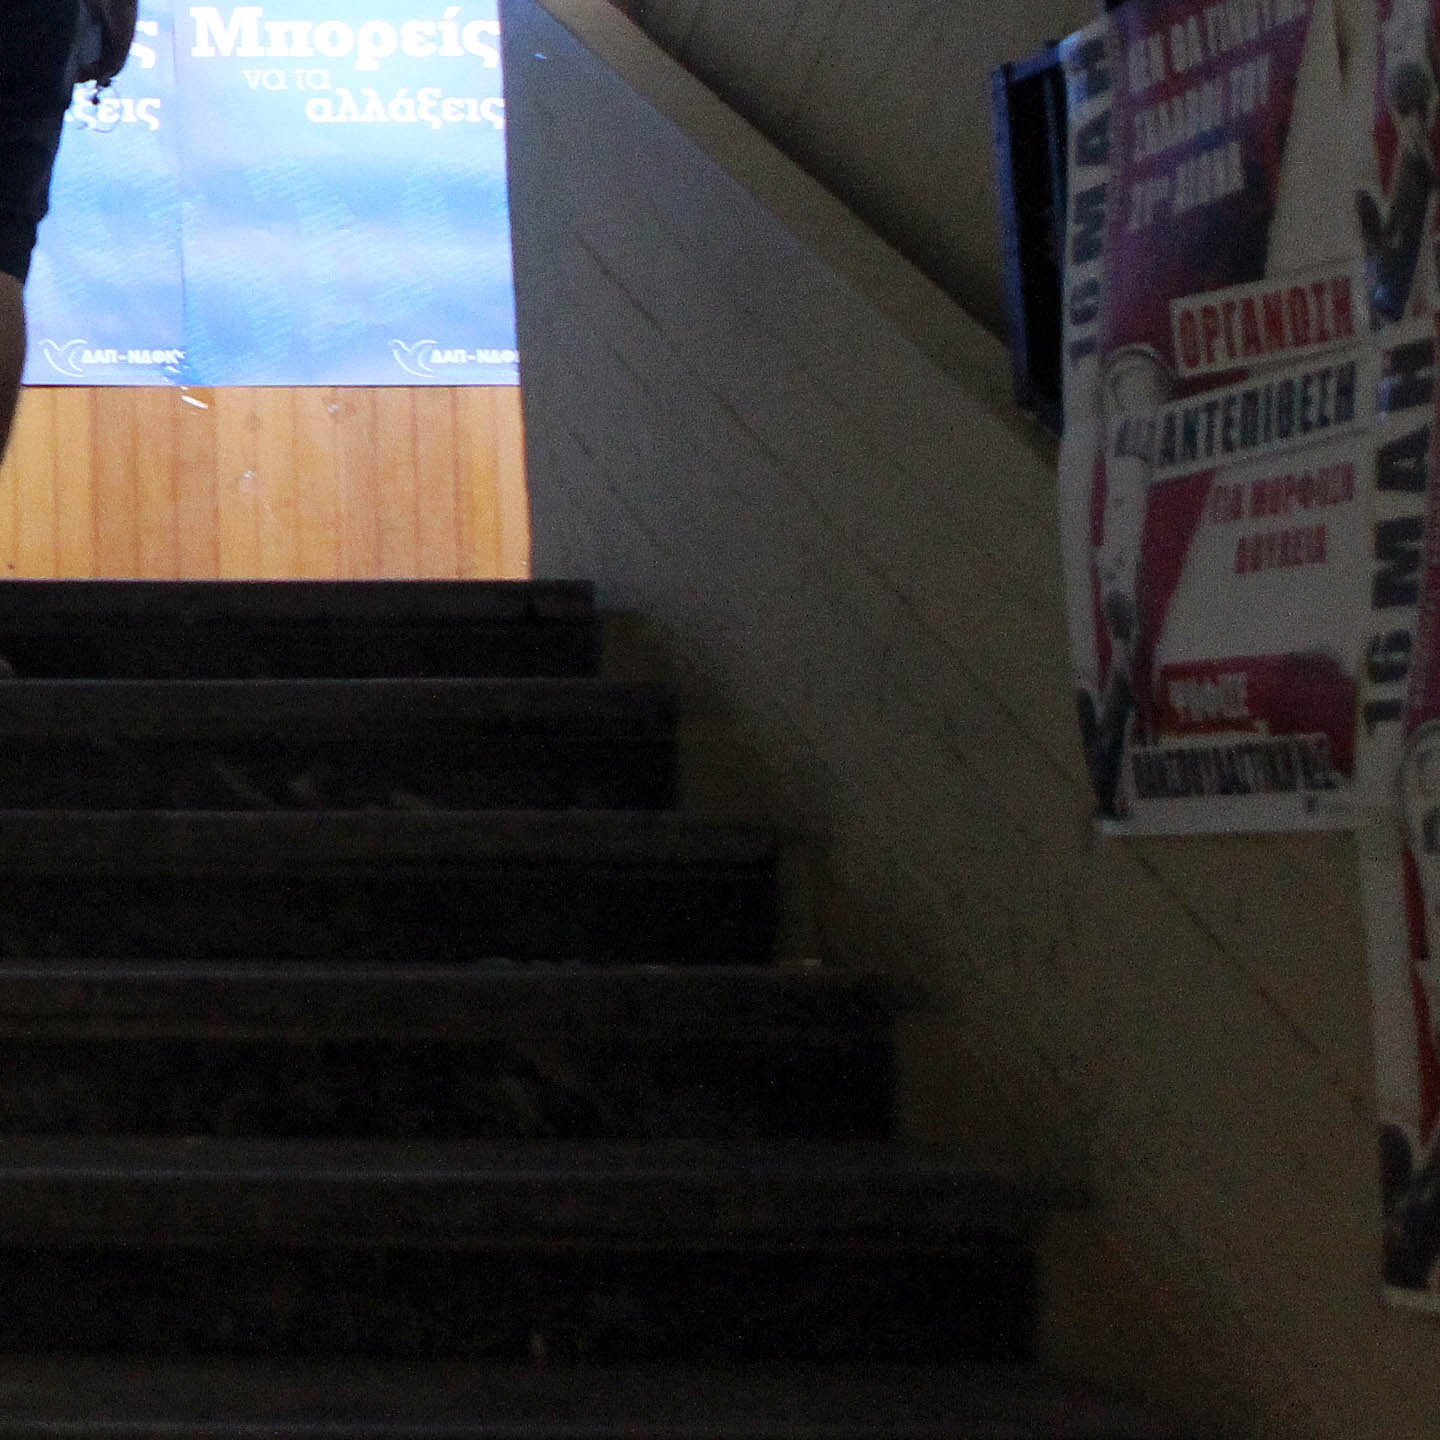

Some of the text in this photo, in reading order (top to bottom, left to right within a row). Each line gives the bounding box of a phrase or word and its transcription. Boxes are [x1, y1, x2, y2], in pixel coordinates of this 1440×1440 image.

[189, 6, 501, 71] Μπορείς
[242, 67, 332, 92] να τα
[304, 87, 505, 130] αλλάξεις
[1177, 274, 1356, 370] ΟΡΓΑΝΩΣΗ
